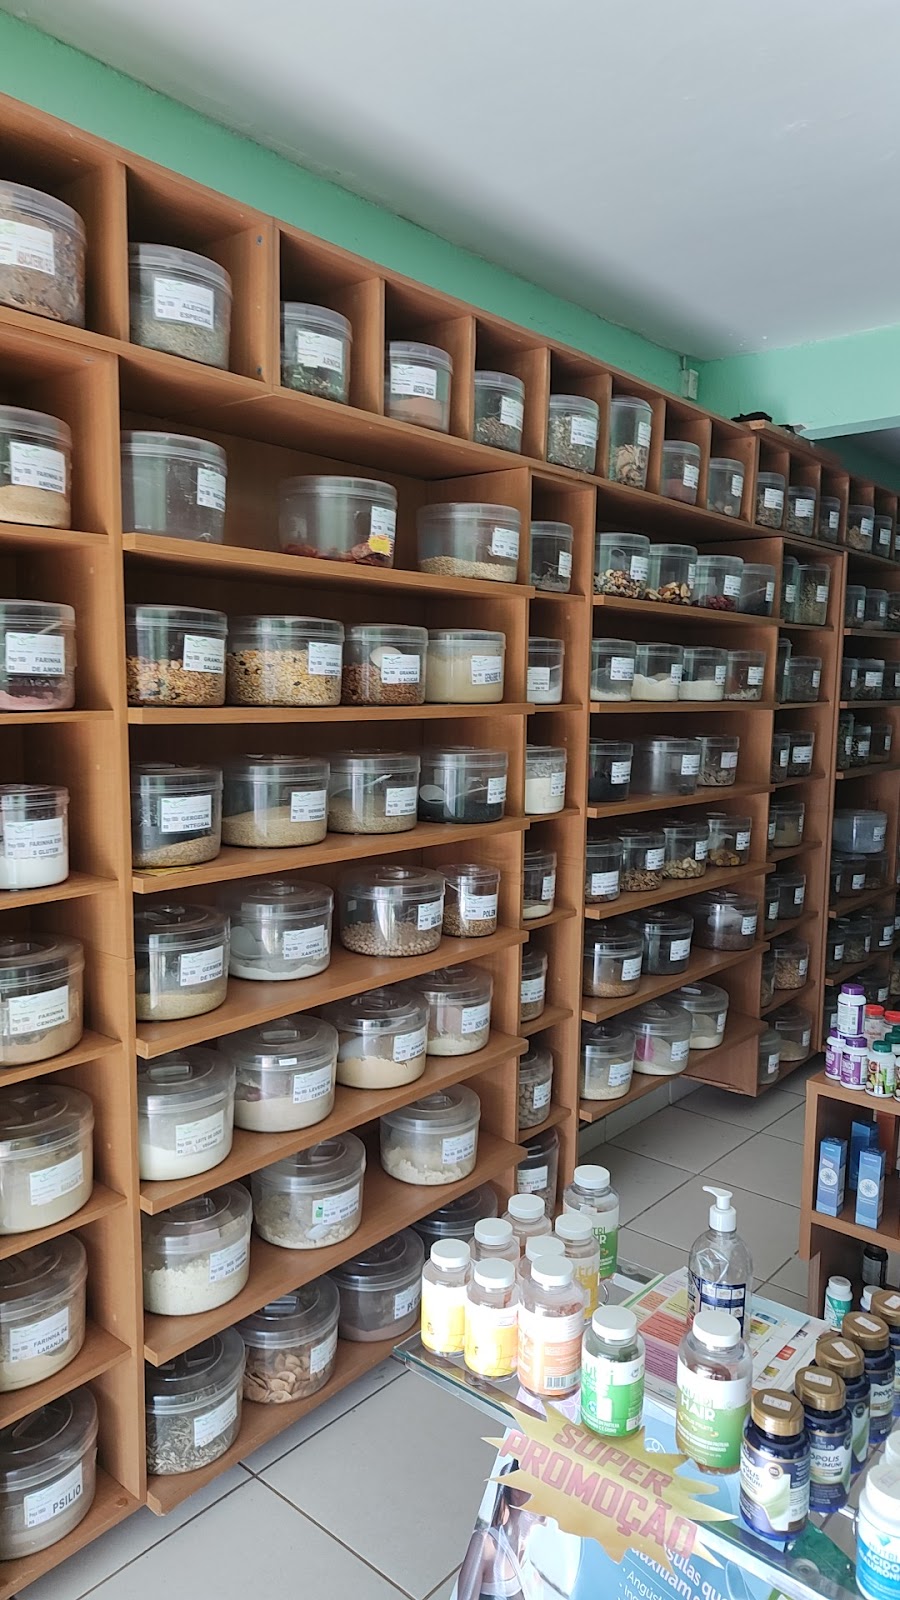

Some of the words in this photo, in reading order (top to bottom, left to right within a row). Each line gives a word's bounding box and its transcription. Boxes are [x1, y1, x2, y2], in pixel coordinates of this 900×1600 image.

[179, 311, 212, 326] ESPECIAL
[34, 656, 62, 664] FARINHA
[42, 665, 63, 673] AMORA
[182, 821, 210, 830] INTEGRAL
[29, 839, 54, 848] FARINHA
[36, 1015, 65, 1028] CENOURA
[37, 1008, 64, 1021] FARINHA
[33, 1333, 61, 1348] FARINHA
[37, 1337, 64, 1355] LARANJA
[681, 1393, 716, 1422] HAIR
[556, 1422, 693, 1497] SUPER
[52, 1484, 81, 1514] PSILIO
[499, 1428, 698, 1561] PROMOÇÃO
